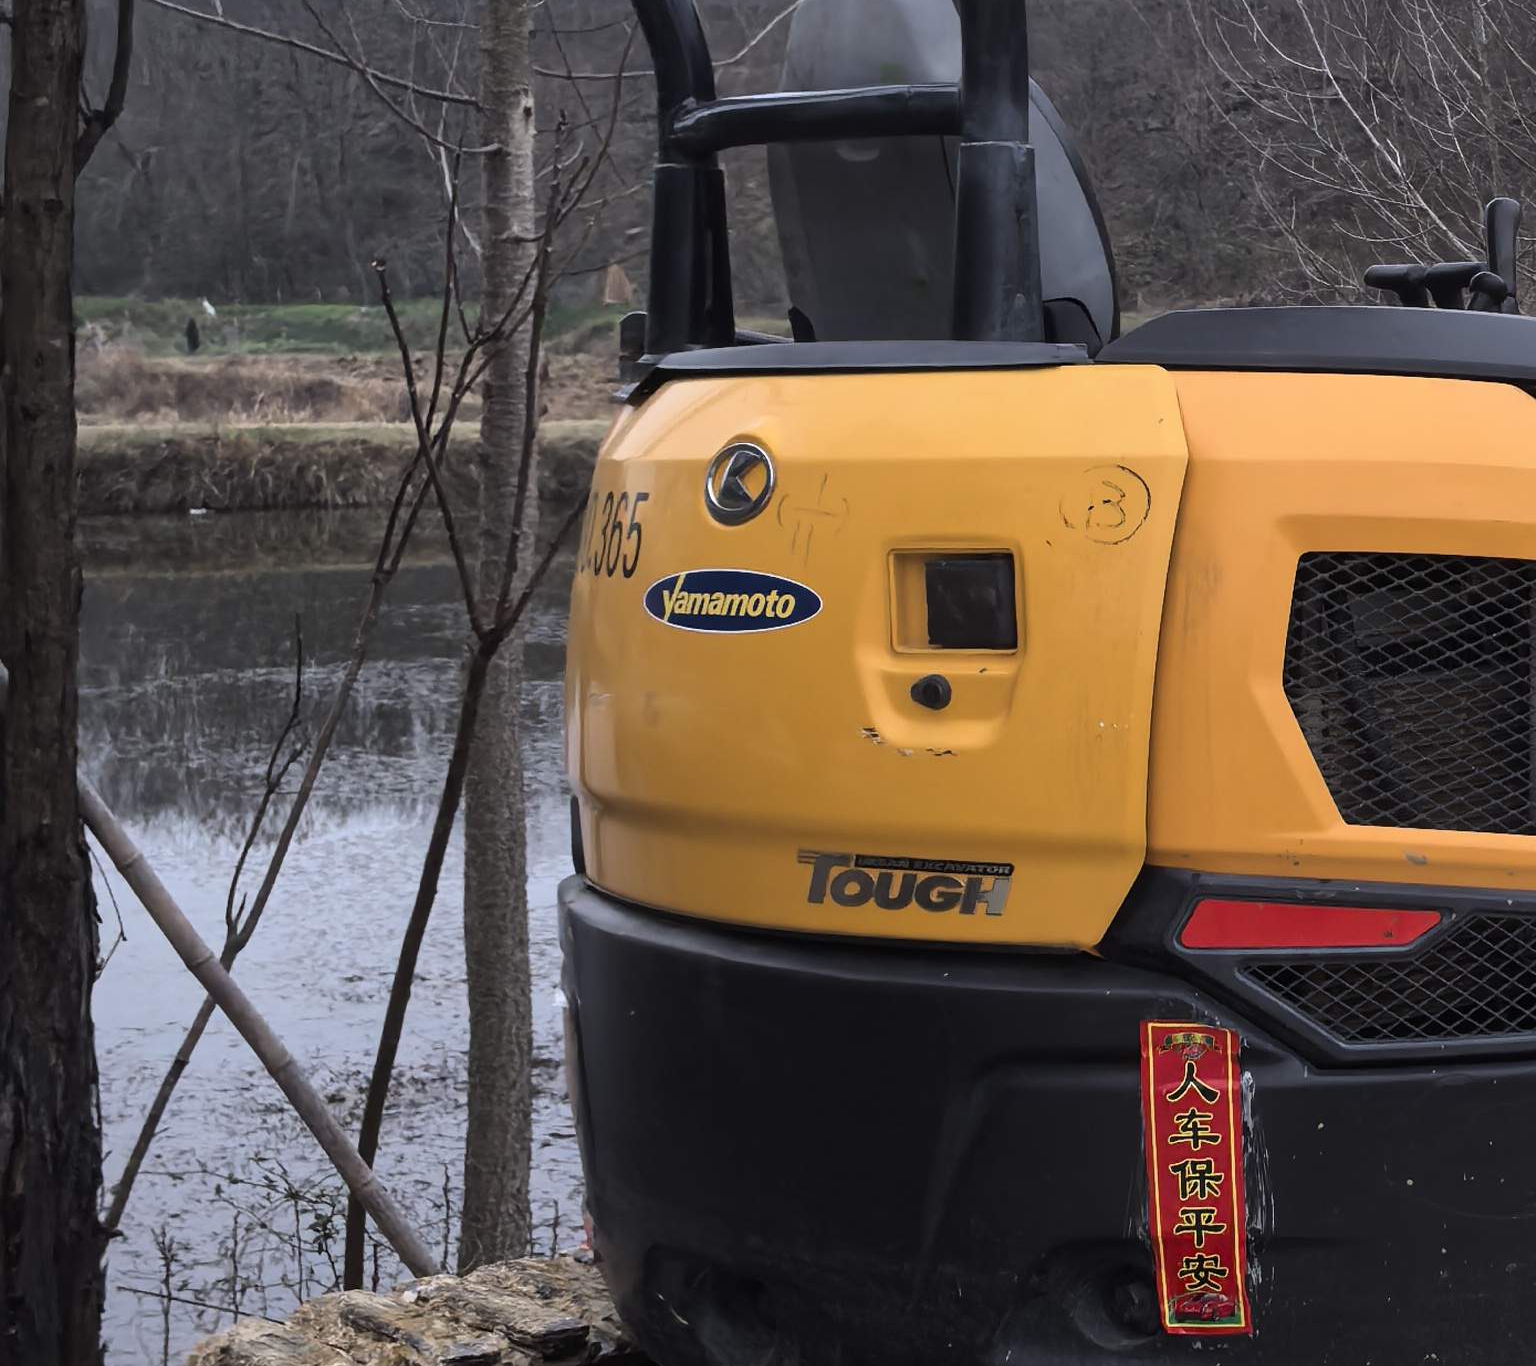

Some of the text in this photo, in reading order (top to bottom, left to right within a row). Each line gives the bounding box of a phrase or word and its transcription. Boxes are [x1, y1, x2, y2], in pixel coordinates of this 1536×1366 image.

[1166, 1060, 1229, 1293] 人车保平安
